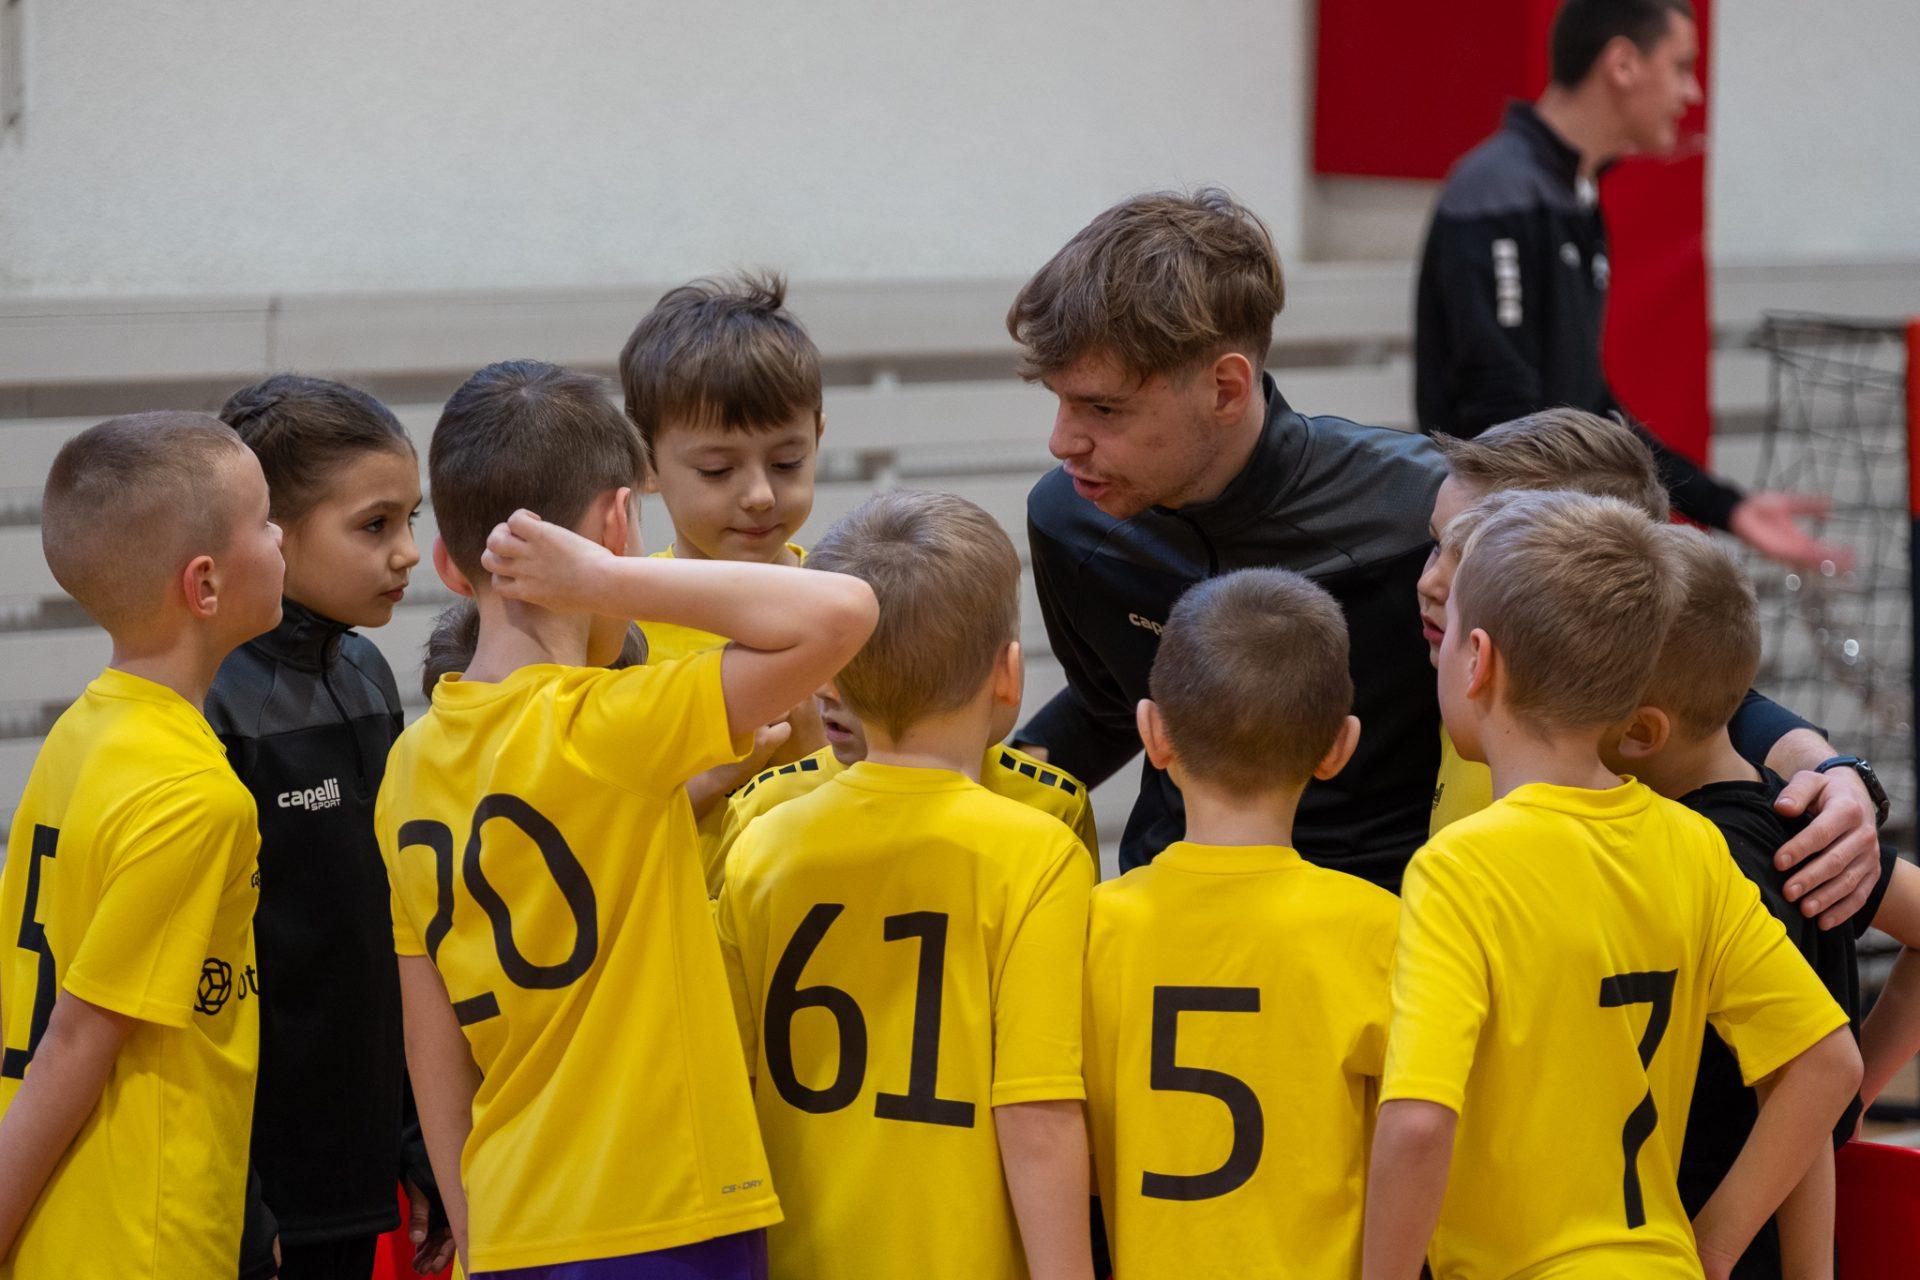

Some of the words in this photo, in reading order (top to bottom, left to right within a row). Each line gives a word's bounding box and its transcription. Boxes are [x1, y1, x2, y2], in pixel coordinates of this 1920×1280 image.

[277, 777, 340, 810] capelli
[310, 798, 341, 811] SPORT
[397, 792, 599, 1028] 20
[763, 903, 976, 1129] 61
[1141, 985, 1265, 1202] 5
[1599, 968, 1679, 1230] 7
